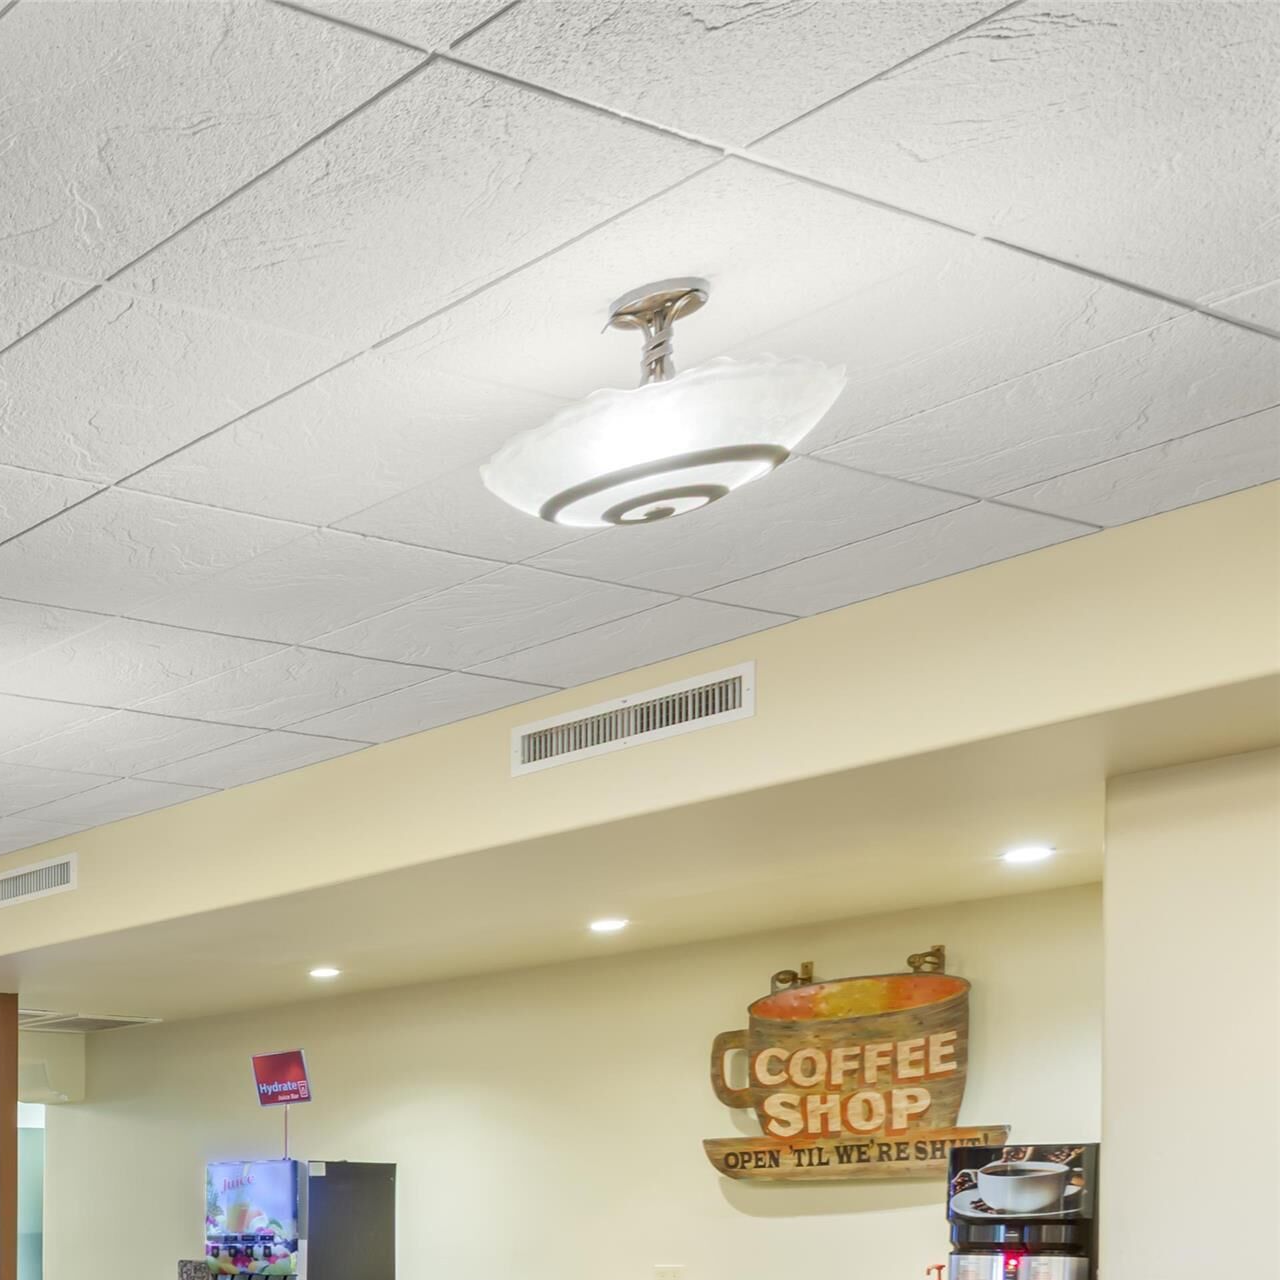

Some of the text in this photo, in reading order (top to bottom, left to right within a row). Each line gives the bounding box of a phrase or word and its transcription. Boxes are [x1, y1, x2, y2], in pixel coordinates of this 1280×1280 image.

[753, 1030, 958, 1089] COFFEE
[259, 1080, 298, 1096] Hydrate
[763, 1087, 932, 1138] SHOP
[724, 1149, 781, 1170] OPEN
[788, 1144, 830, 1167] 'TIL
[834, 1138, 910, 1165] WE'RE
